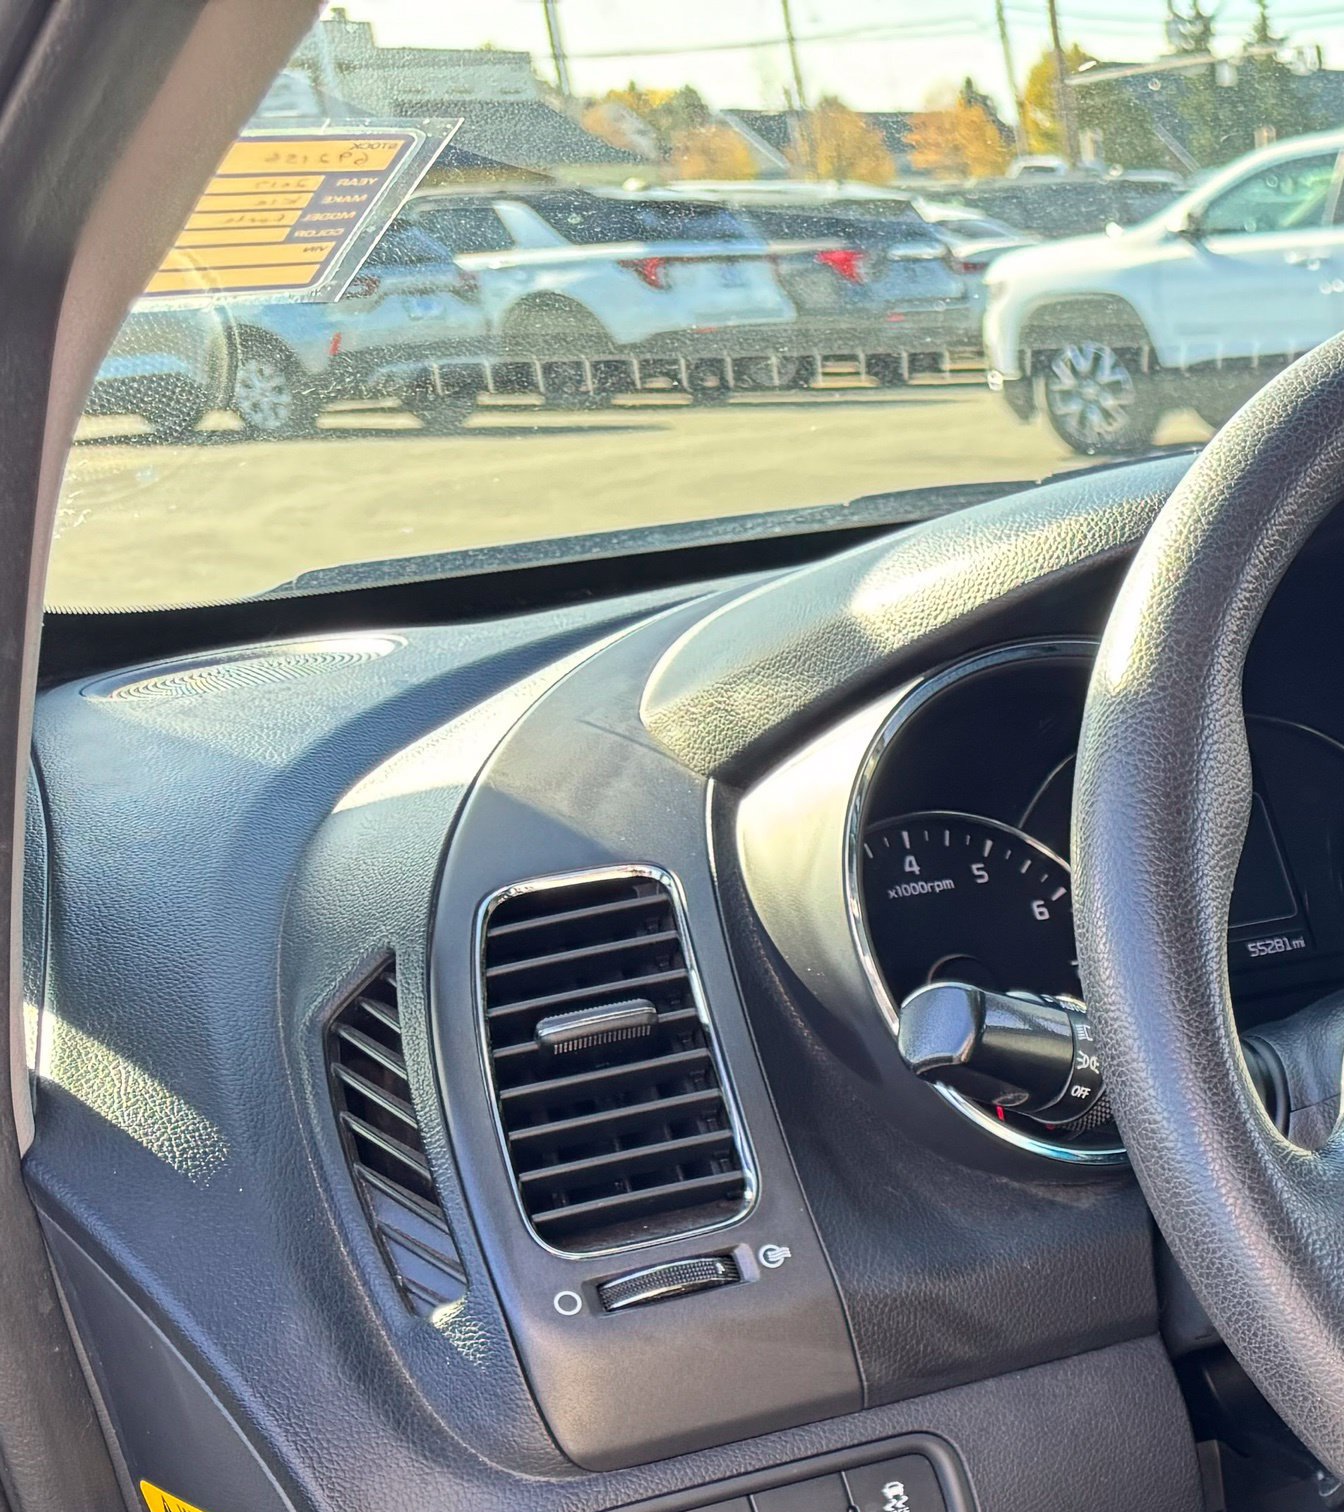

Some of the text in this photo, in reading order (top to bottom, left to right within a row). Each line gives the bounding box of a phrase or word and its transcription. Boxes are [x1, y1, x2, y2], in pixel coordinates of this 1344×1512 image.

[903, 855, 921, 876] 4
[970, 863, 989, 884] 5
[887, 878, 955, 900] x1000rpm
[1031, 900, 1050, 921] 6
[1071, 1084, 1092, 1099] OFF
